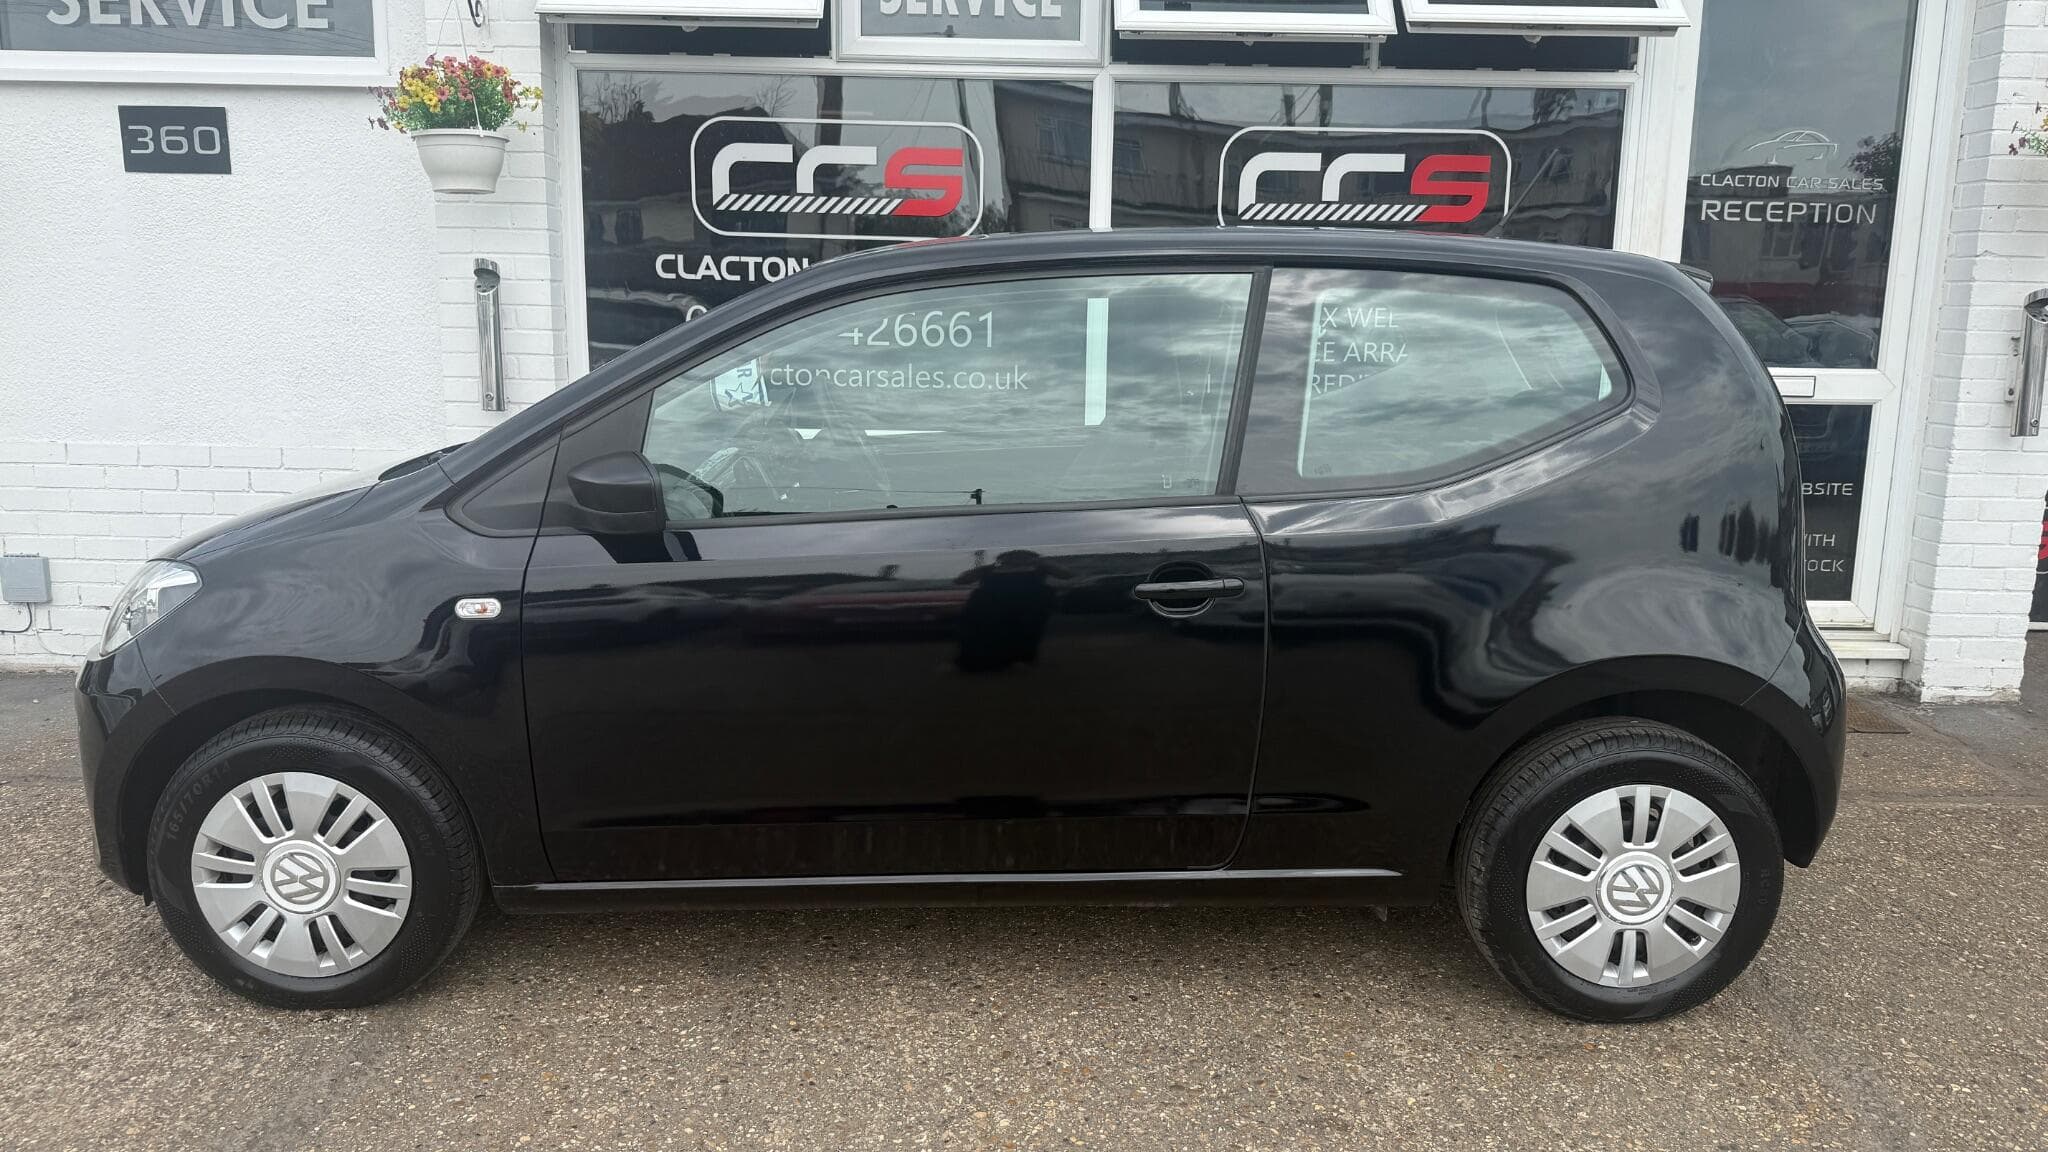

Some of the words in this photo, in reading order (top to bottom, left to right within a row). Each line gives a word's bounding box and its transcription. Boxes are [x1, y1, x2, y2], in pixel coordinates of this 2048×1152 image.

[127, 124, 222, 156] 360
[1700, 174, 1780, 188] CLACTON
[1786, 177, 1822, 189] CAR
[1828, 177, 1885, 191] SALES
[1700, 200, 1878, 225] RECEPTION
[655, 253, 810, 283] CLACTON
[1804, 533, 1836, 547] ITH
[1805, 559, 1845, 572] OCK
